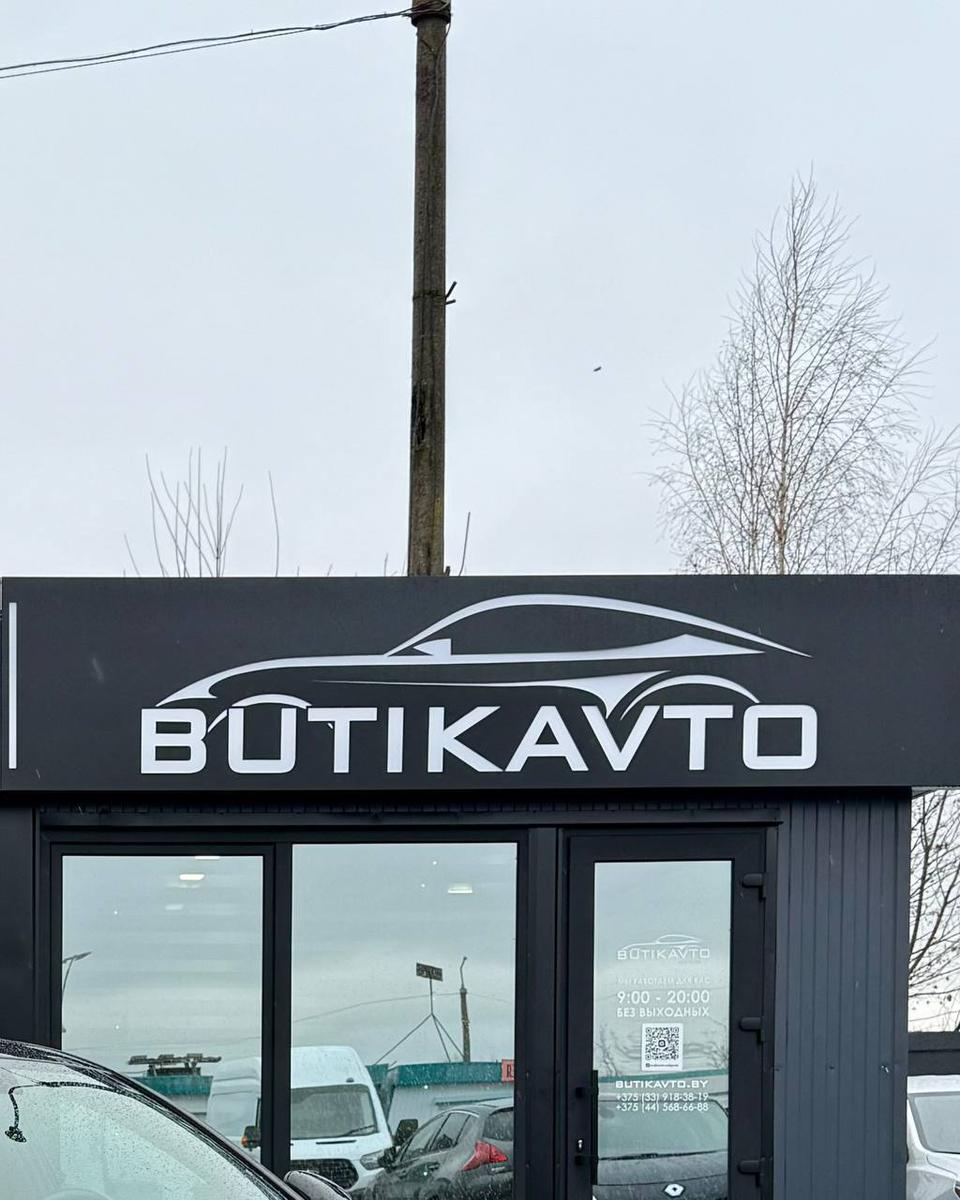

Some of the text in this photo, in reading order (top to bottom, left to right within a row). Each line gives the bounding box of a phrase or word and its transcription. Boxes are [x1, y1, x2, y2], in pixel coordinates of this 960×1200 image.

[140, 703, 818, 775] BUTIKAVTO
[617, 948, 710, 960] BUTIKAVTO
[617, 991, 650, 1004] 9:00
[667, 990, 710, 1004] 20:00
[617, 1007, 710, 1018] БЕЗ ВЫХОДНЫХ
[615, 1080, 709, 1089] BUTIKAVTO.BY
[616, 1092, 709, 1104] +375 (33) 918-38-19
[616, 1102, 709, 1114] +375 (44) 568-66-88
